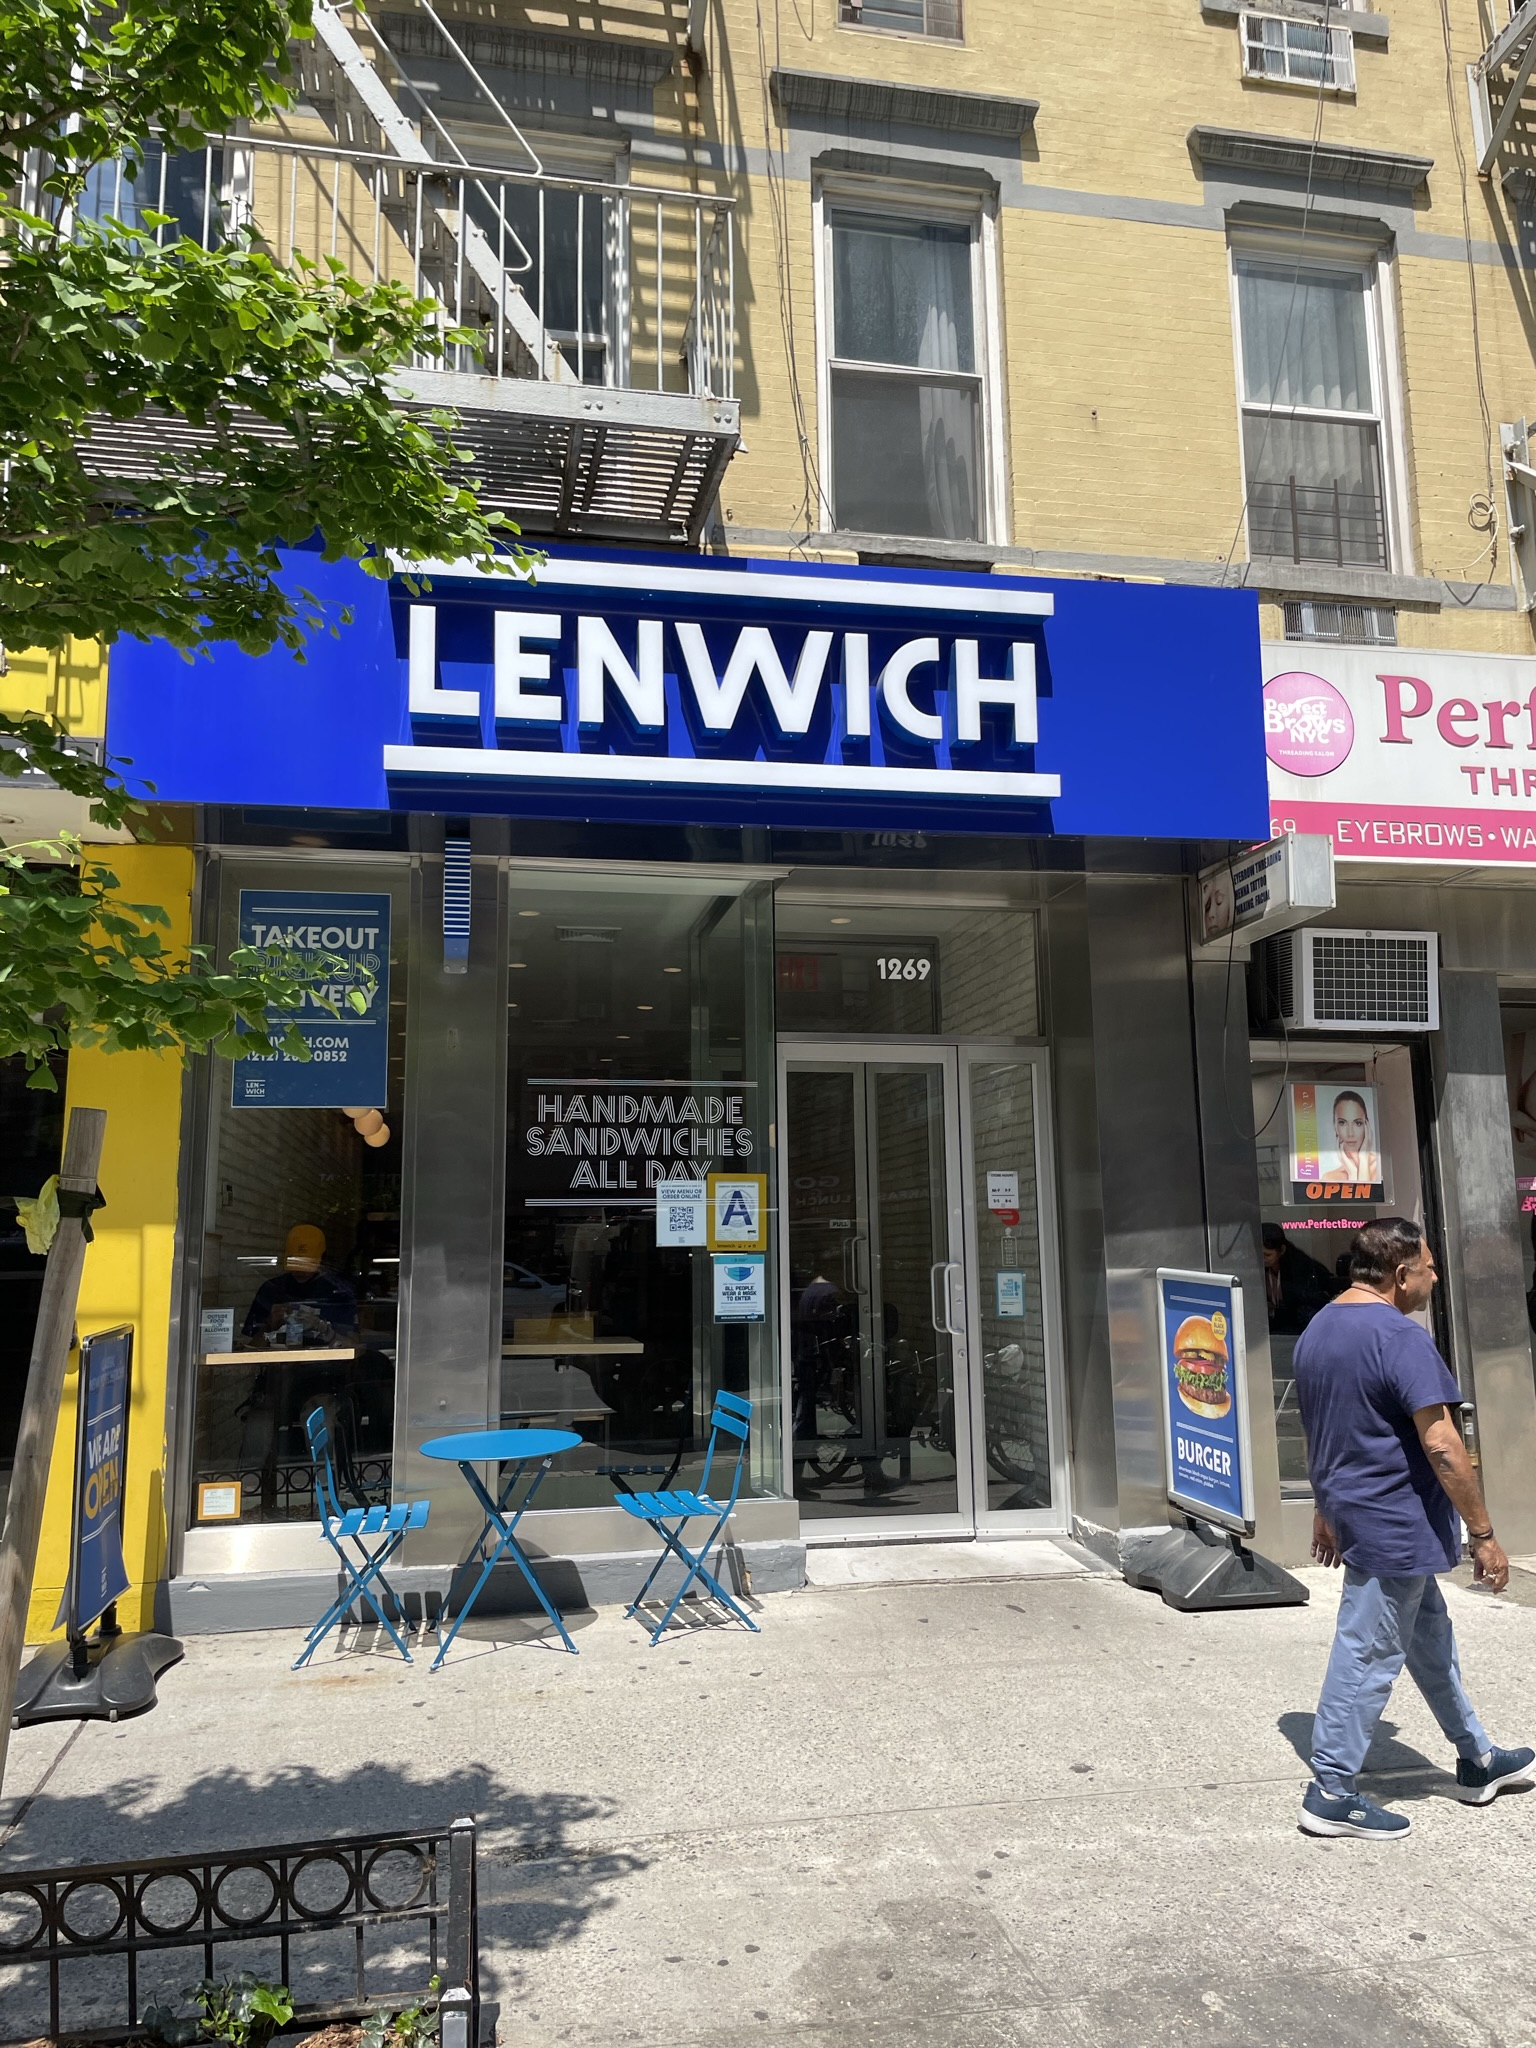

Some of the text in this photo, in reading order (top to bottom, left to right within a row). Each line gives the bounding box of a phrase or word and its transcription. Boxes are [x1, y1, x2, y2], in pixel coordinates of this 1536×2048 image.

[409, 604, 1039, 744] LENWICH
[1264, 697, 1327, 717] Perfect
[1264, 711, 1346, 734] Brows
[1290, 730, 1329, 744] NYC
[1337, 819, 1483, 847] EYEBROWS
[1233, 850, 1282, 885] EYEBROW THREADING
[1250, 875, 1267, 894] TATTOO
[252, 924, 379, 950] TAKEOUT
[877, 958, 931, 981] 1269
[538, 1094, 744, 1124] HANDMADE
[526, 1126, 754, 1157] SANDWICHES
[569, 1160, 713, 1189] ALL DAY
[1306, 1183, 1372, 1200] OPEN
[721, 1190, 753, 1226] A
[88, 1423, 121, 1470] WE ARE
[1177, 1437, 1232, 1477] BURGER
[84, 1456, 120, 1520] OPEN
